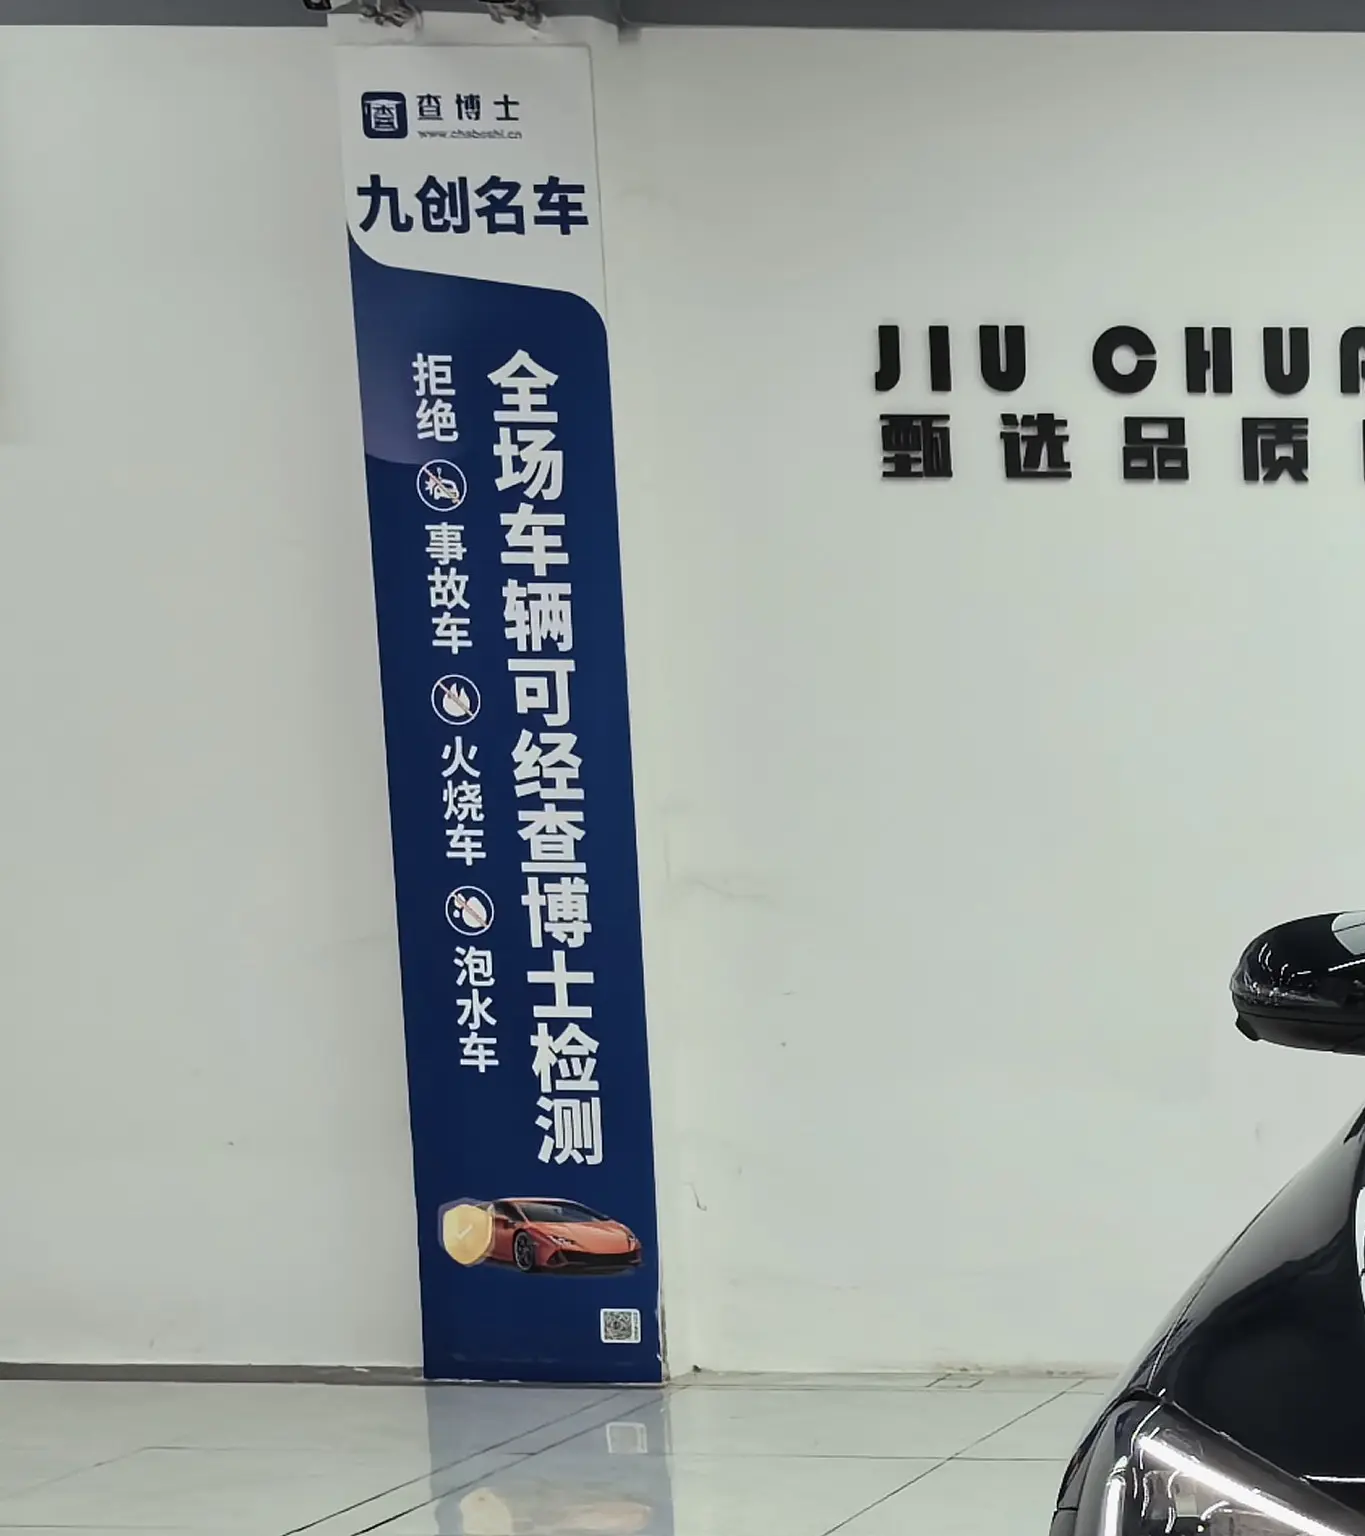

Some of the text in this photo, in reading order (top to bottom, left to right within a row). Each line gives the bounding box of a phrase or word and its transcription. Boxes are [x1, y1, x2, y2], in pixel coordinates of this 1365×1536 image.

[416, 93, 520, 121] 查博士
[356, 174, 589, 236] 九创名车
[411, 352, 459, 443] 拒绝
[874, 325, 1027, 392] JIU
[424, 521, 473, 655] 事故车
[440, 735, 487, 866] 火烧车
[486, 349, 604, 1166] 全场车辆可经查博士检测
[453, 945, 500, 1073] 泡水车
